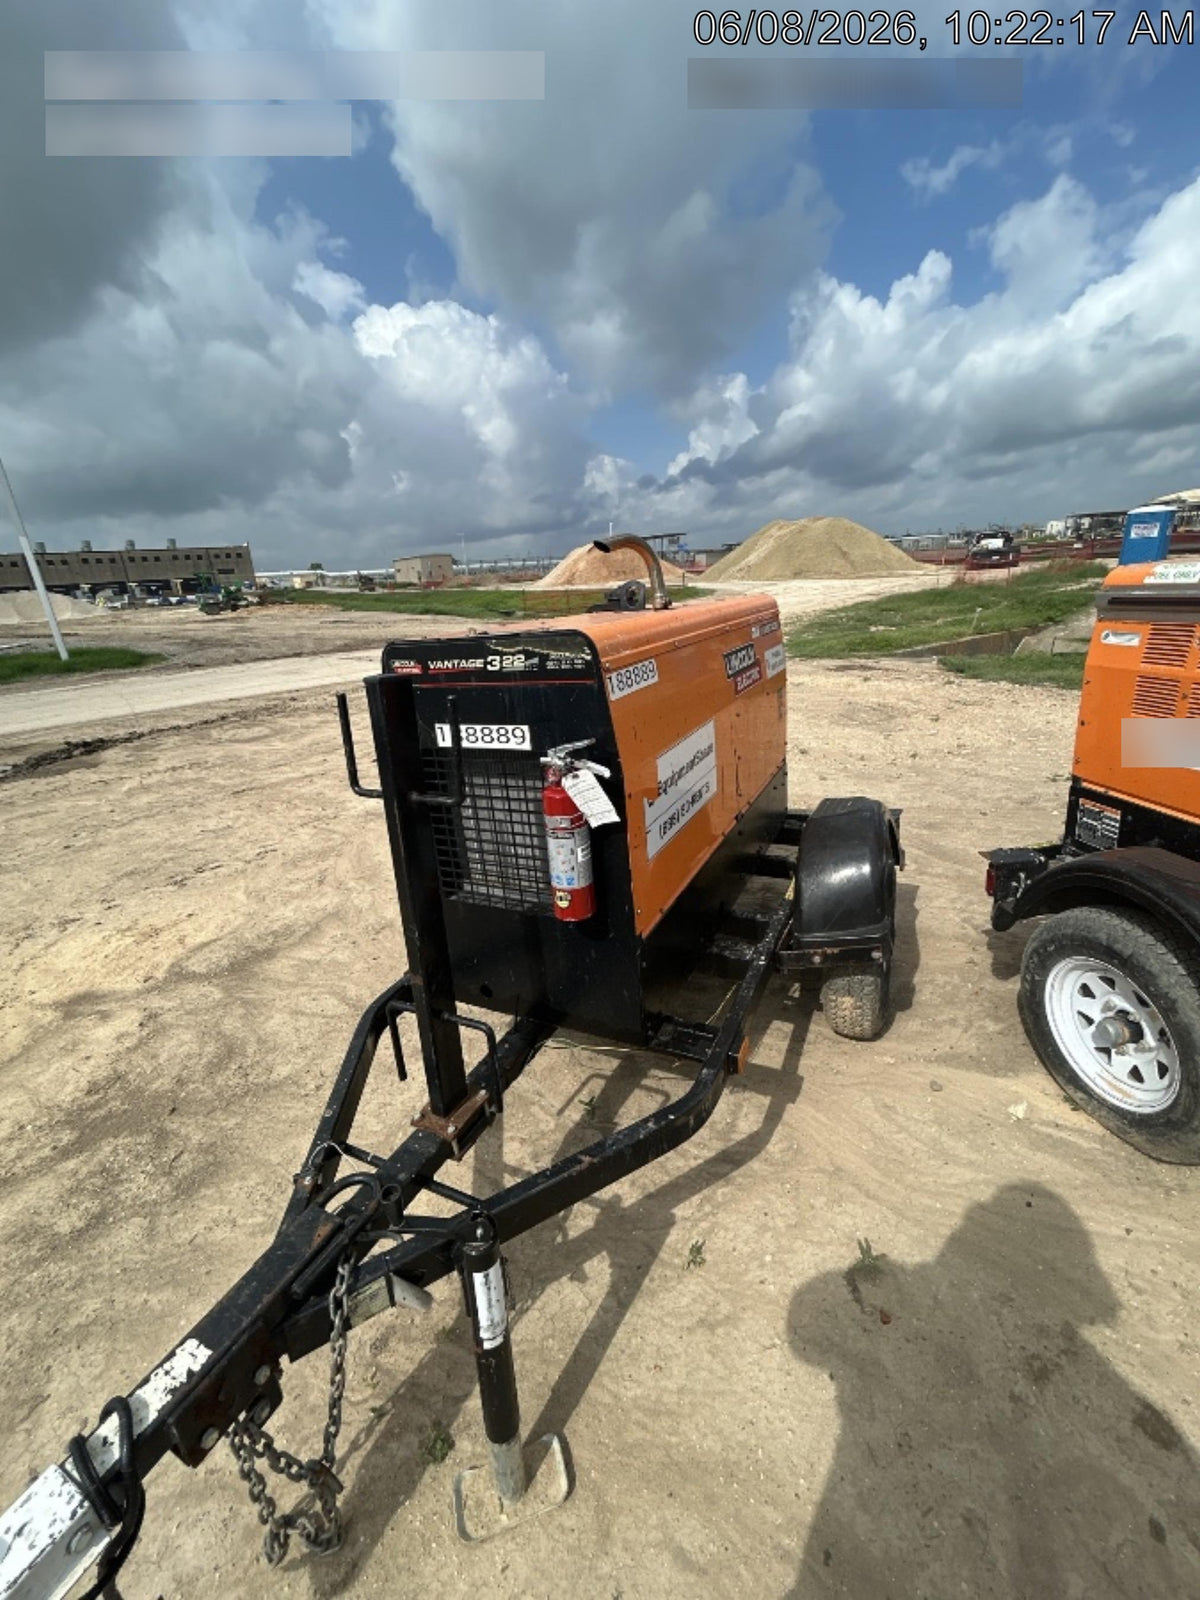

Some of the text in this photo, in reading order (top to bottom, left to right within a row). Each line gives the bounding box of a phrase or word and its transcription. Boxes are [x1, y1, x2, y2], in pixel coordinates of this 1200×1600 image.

[427, 659, 485, 670] VANTAGE
[486, 653, 525, 671] 322
[606, 660, 657, 696] 188889
[436, 726, 527, 746] 18889
